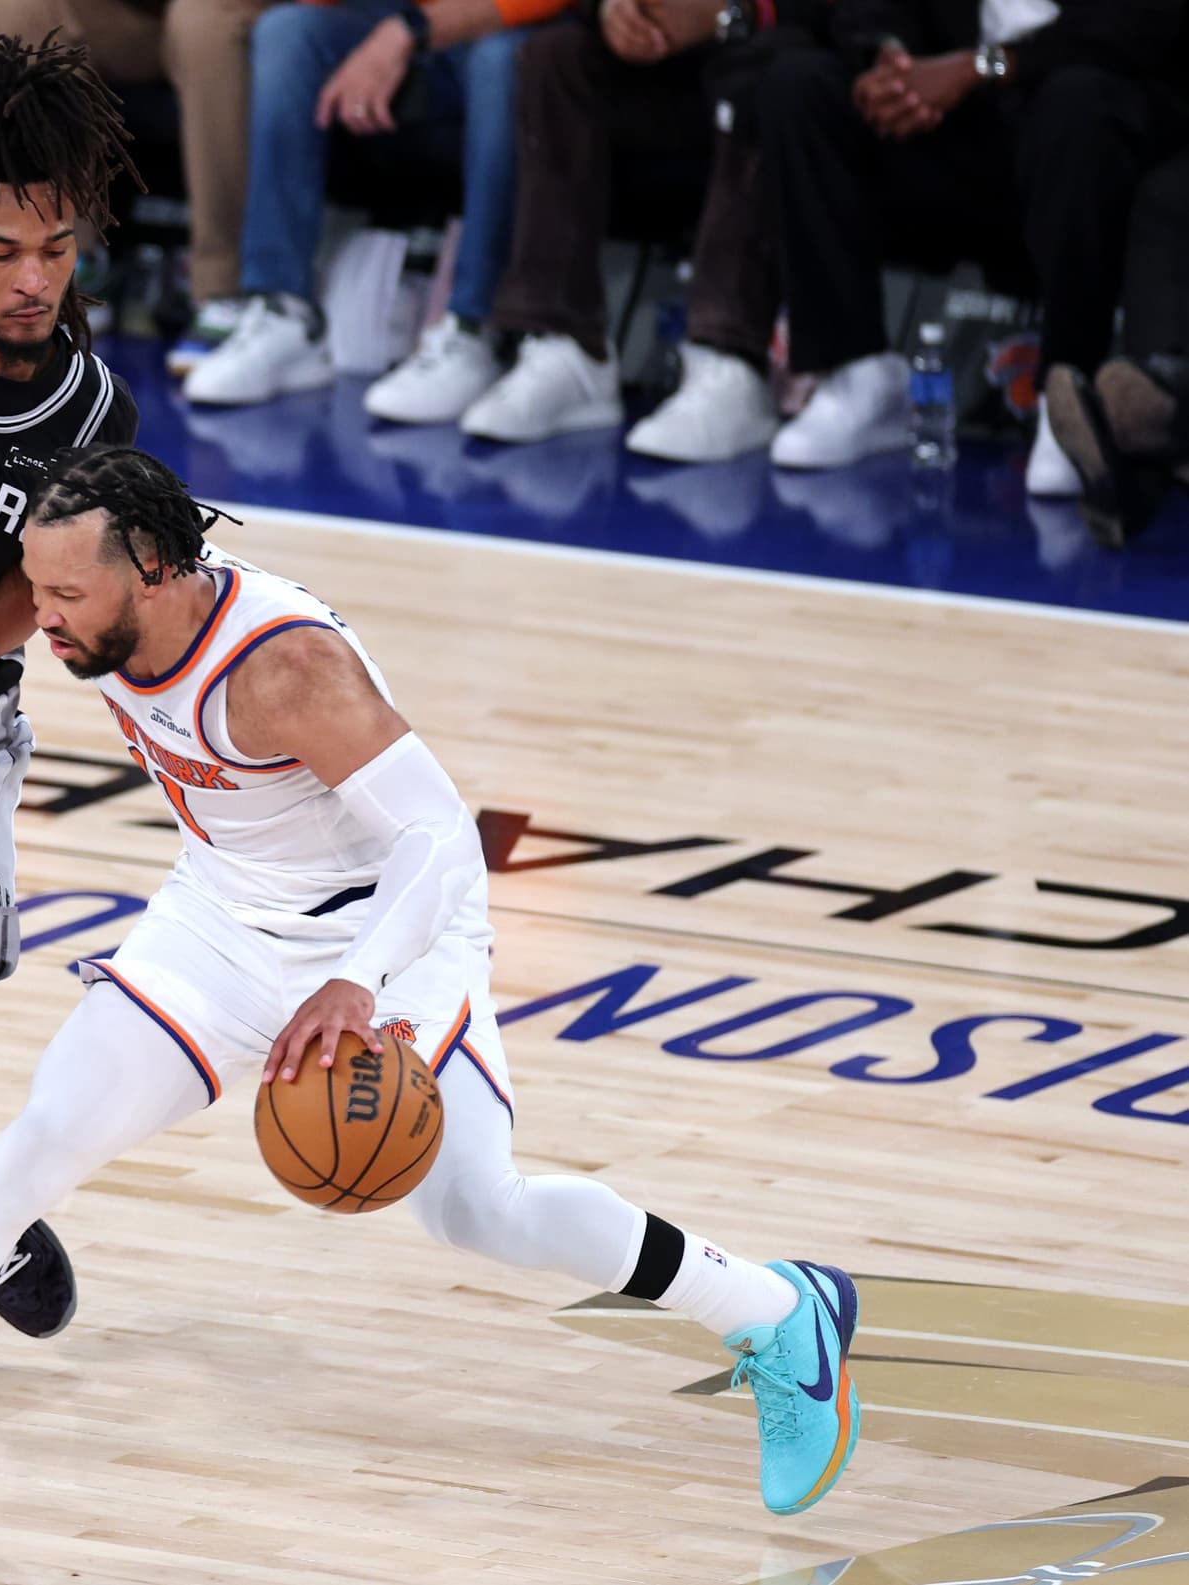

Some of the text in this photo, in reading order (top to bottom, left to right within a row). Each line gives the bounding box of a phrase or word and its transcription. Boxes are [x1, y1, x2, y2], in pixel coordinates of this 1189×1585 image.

[150, 713, 167, 727] abu
[17, 752, 1189, 950] CHAE
[345, 1029, 384, 1123] Wil
